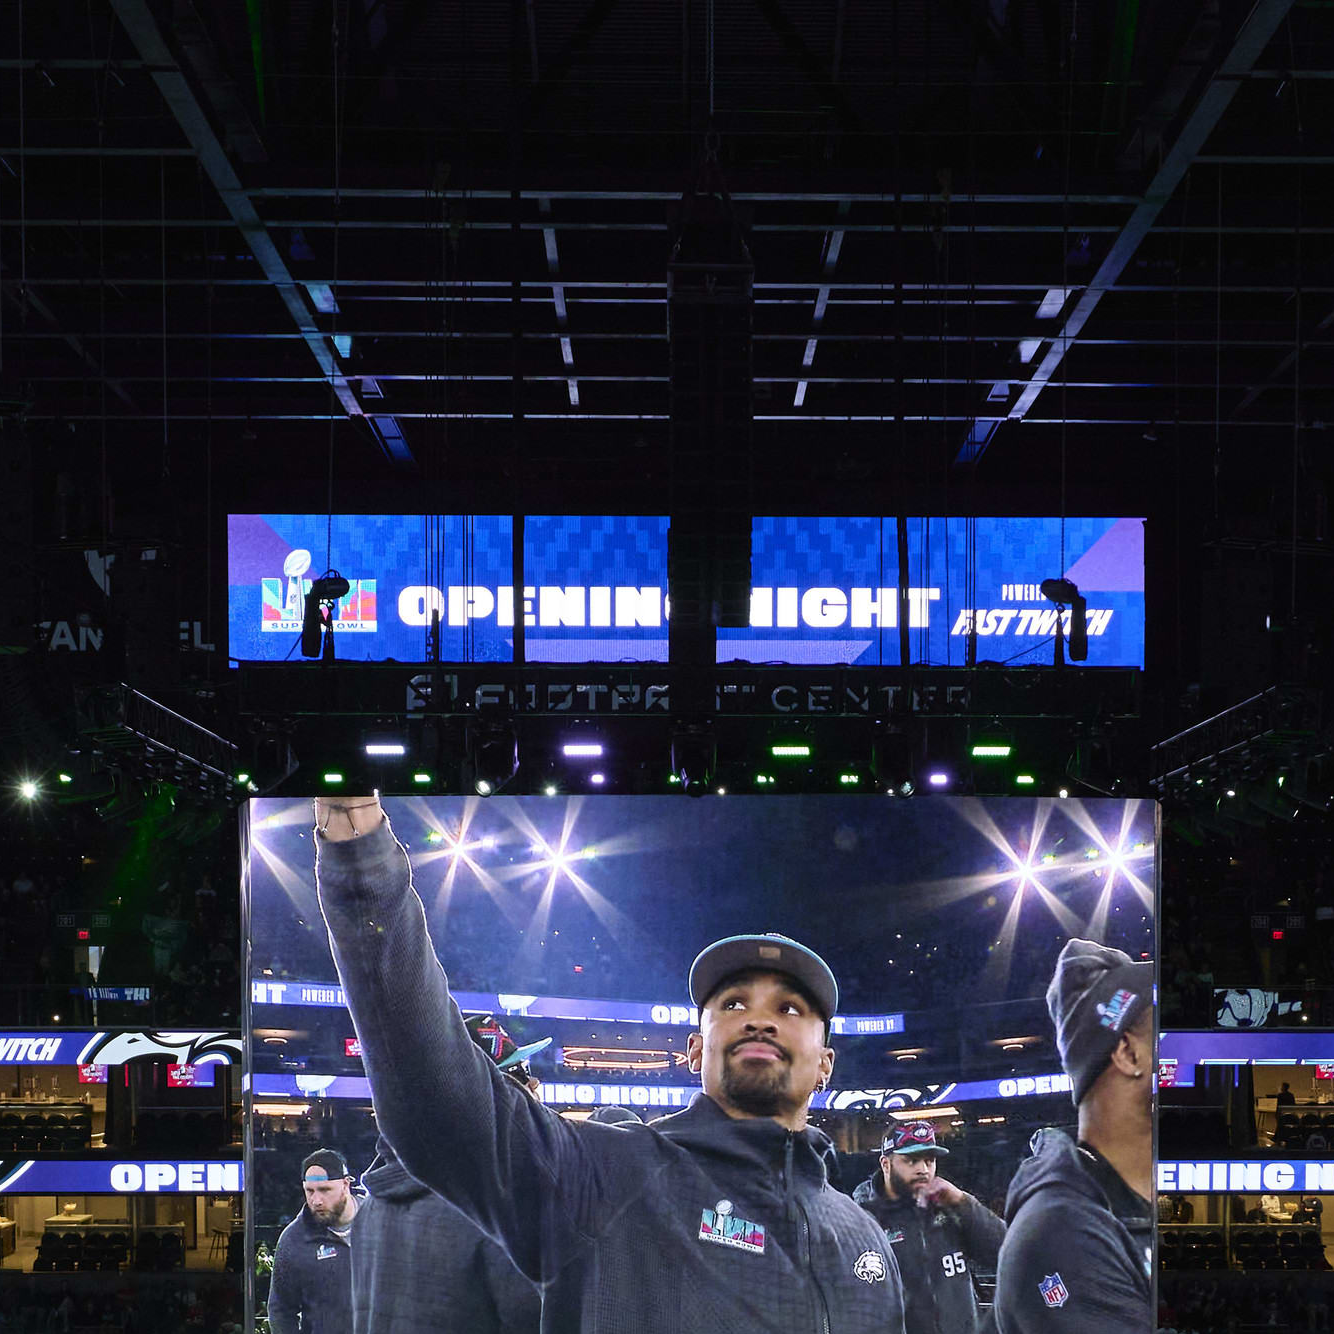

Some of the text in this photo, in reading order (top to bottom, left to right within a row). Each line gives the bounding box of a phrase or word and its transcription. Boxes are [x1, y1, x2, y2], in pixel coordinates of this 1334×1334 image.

[1002, 584, 1046, 602] POWERE
[398, 585, 670, 627] OPENIN
[335, 622, 367, 630] OWL
[951, 609, 1019, 636] FAST
[600, 1085, 685, 1106] NIGHT
[998, 1074, 1074, 1098] OPEN
[110, 1164, 240, 1192] OPEN
[1157, 1162, 1296, 1191] ENING
[942, 1251, 966, 1277] 95
[1044, 1284, 1066, 1304] NFL
